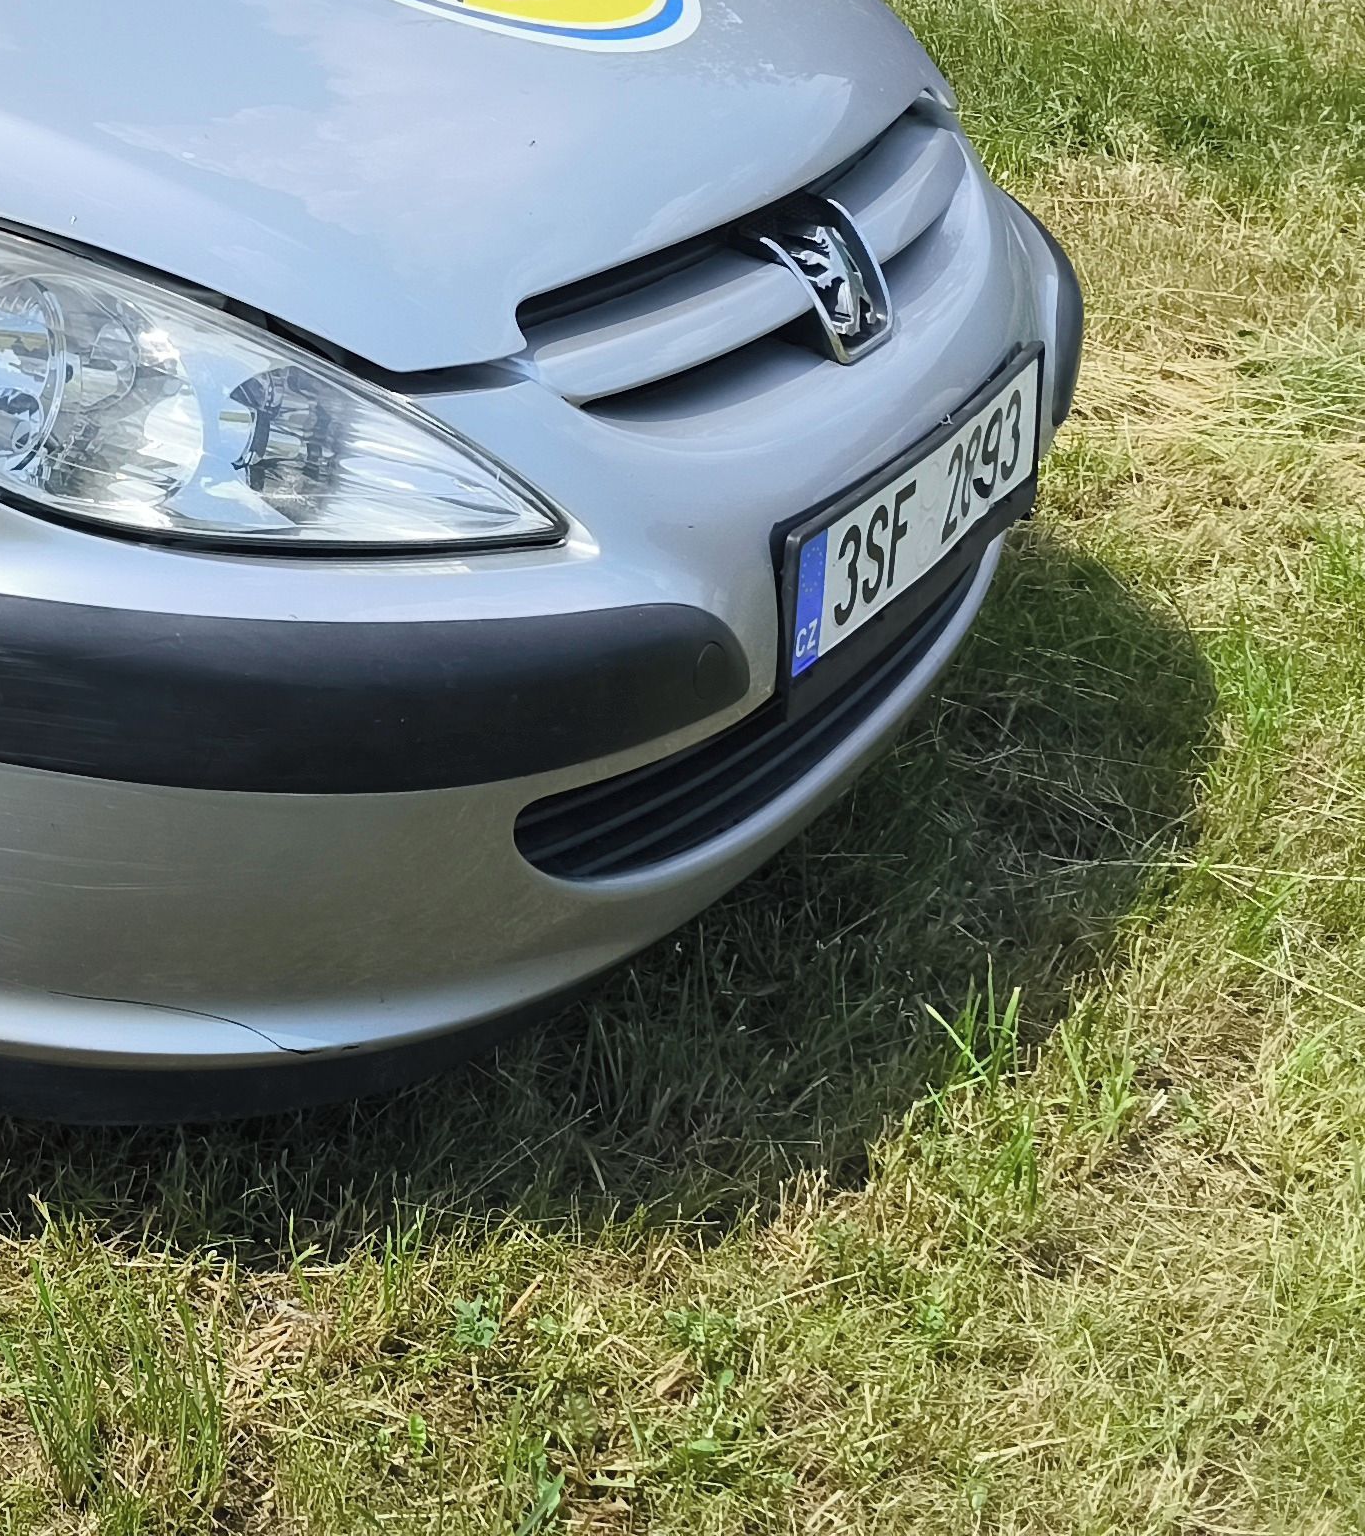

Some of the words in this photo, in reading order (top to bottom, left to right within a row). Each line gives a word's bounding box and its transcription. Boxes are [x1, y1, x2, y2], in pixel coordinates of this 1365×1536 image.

[833, 479, 917, 627] 3SF
[941, 389, 1022, 546] 2893
[795, 618, 818, 658] CZ
